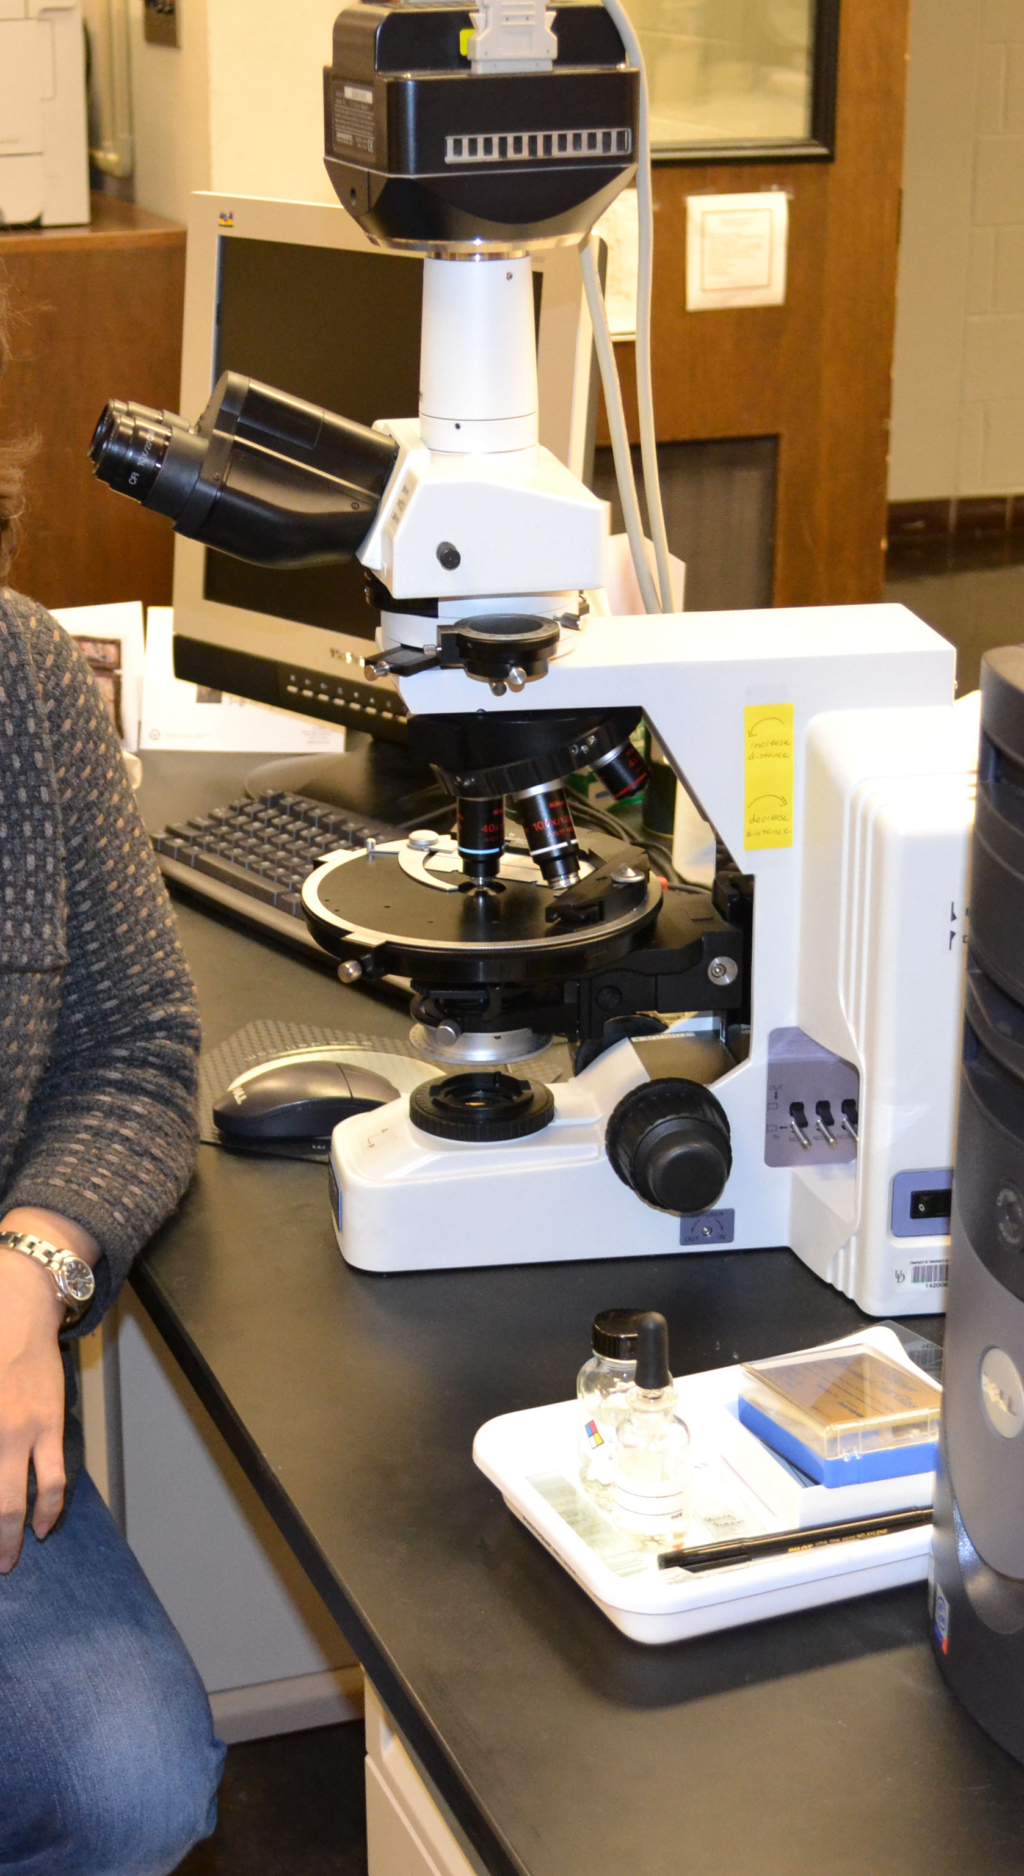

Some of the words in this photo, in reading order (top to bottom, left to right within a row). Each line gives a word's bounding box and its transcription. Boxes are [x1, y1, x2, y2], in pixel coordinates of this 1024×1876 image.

[128, 472, 140, 485] CFI
[750, 739, 791, 749] increase
[748, 751, 790, 760] distance
[749, 814, 789, 824] decrease
[746, 827, 790, 838] distance
